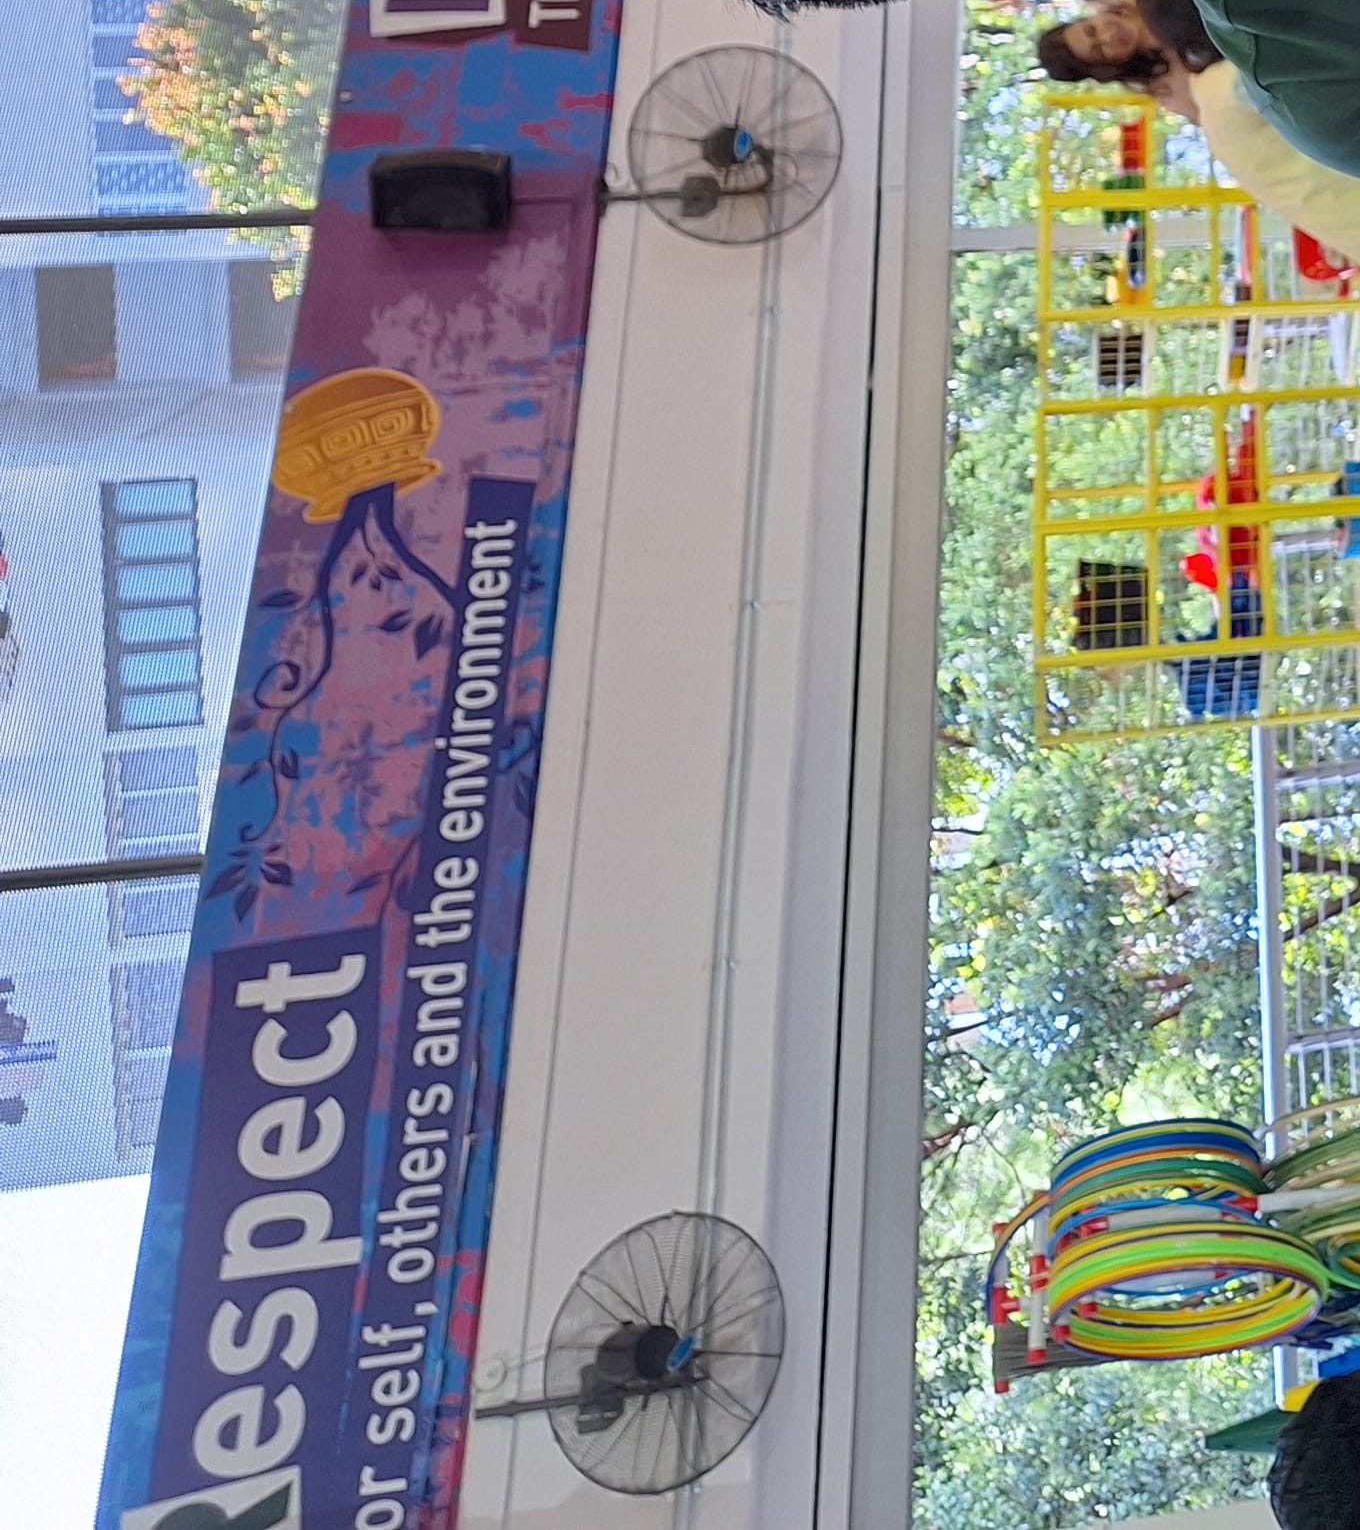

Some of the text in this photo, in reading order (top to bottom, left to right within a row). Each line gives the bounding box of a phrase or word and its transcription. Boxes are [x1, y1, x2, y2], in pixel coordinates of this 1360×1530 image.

[439, 520, 518, 840] environment
[414, 856, 481, 948] the
[407, 961, 468, 1067] and
[376, 1082, 455, 1283] others
[357, 1302, 438, 1444] self,
